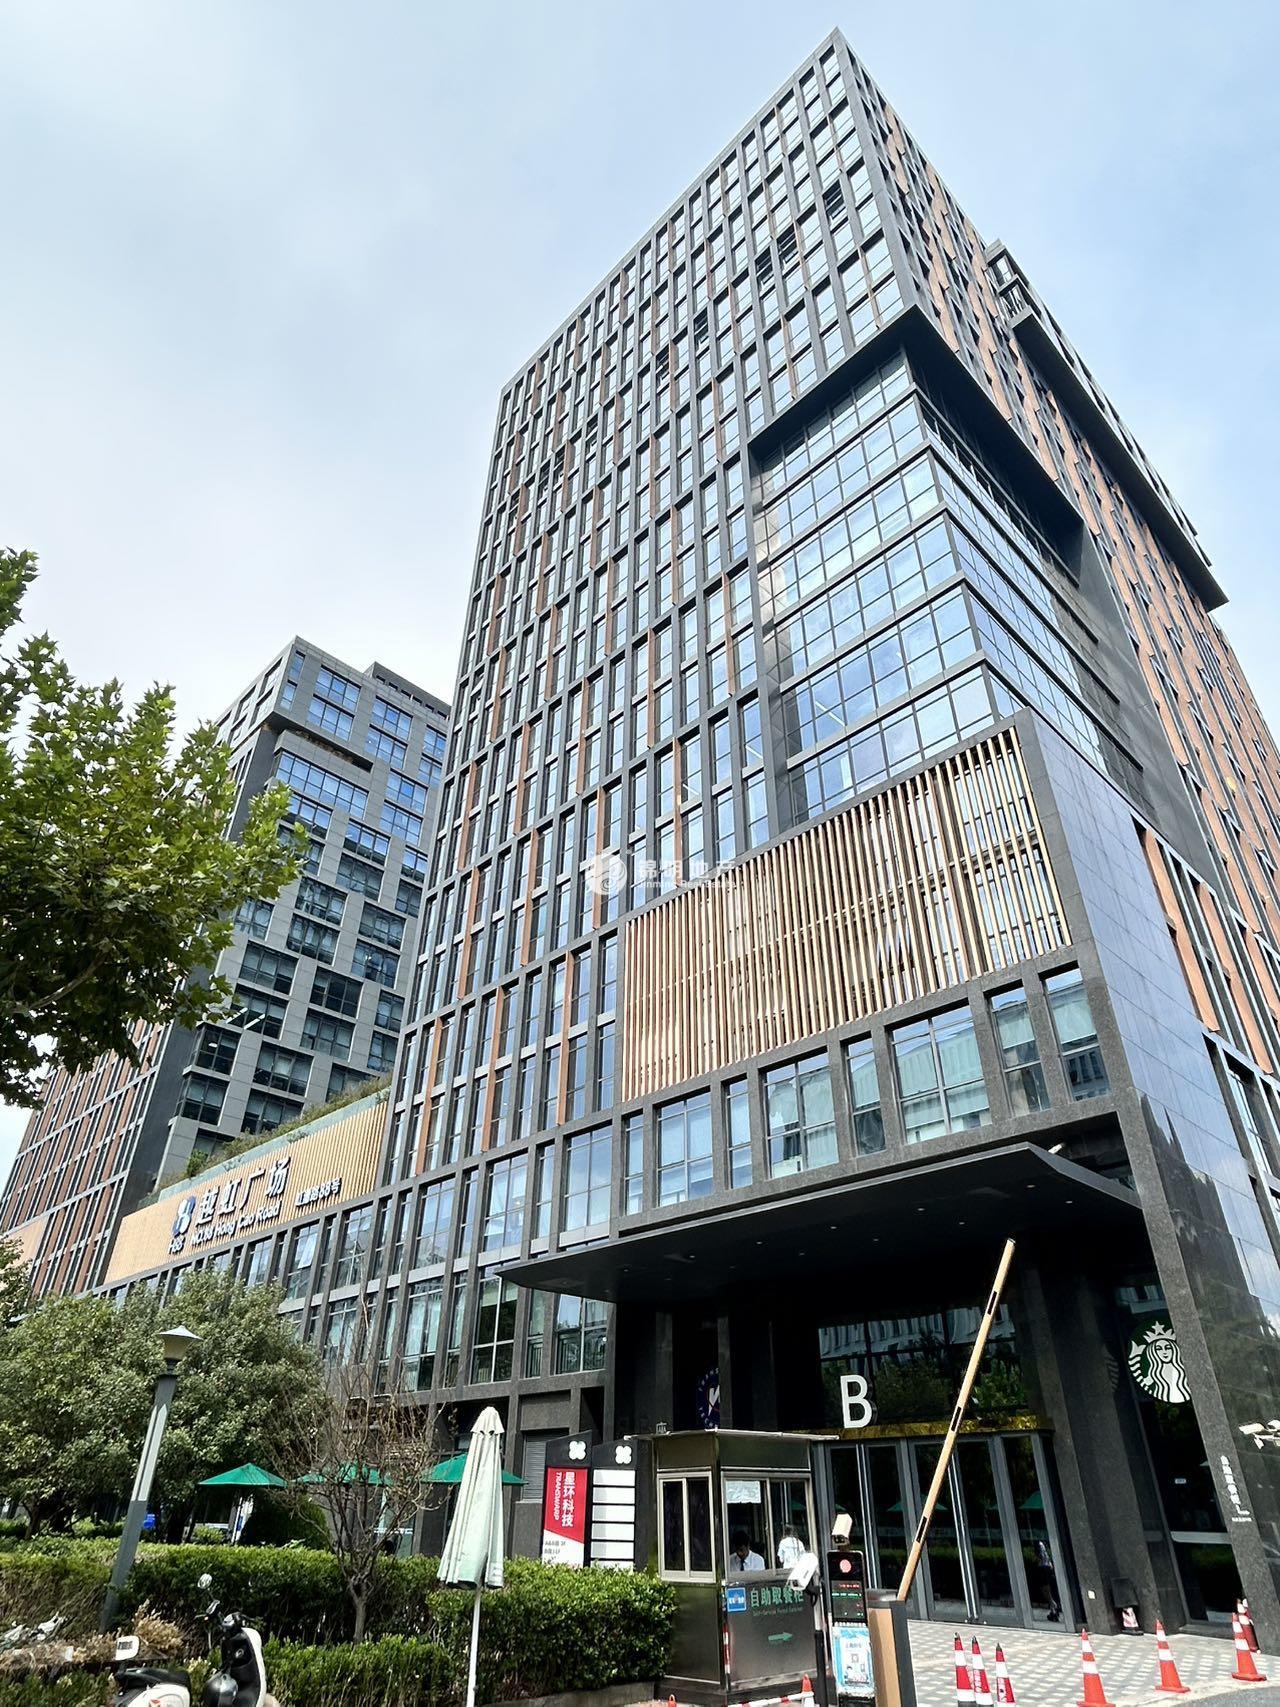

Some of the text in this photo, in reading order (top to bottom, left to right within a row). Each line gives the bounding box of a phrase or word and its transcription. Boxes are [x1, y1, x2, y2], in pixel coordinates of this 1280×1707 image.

[196, 1157, 291, 1225] 越虹广场
[255, 1200, 282, 1222] Road
[840, 1374, 874, 1429] B
[561, 1471, 575, 1527] 星环科技
